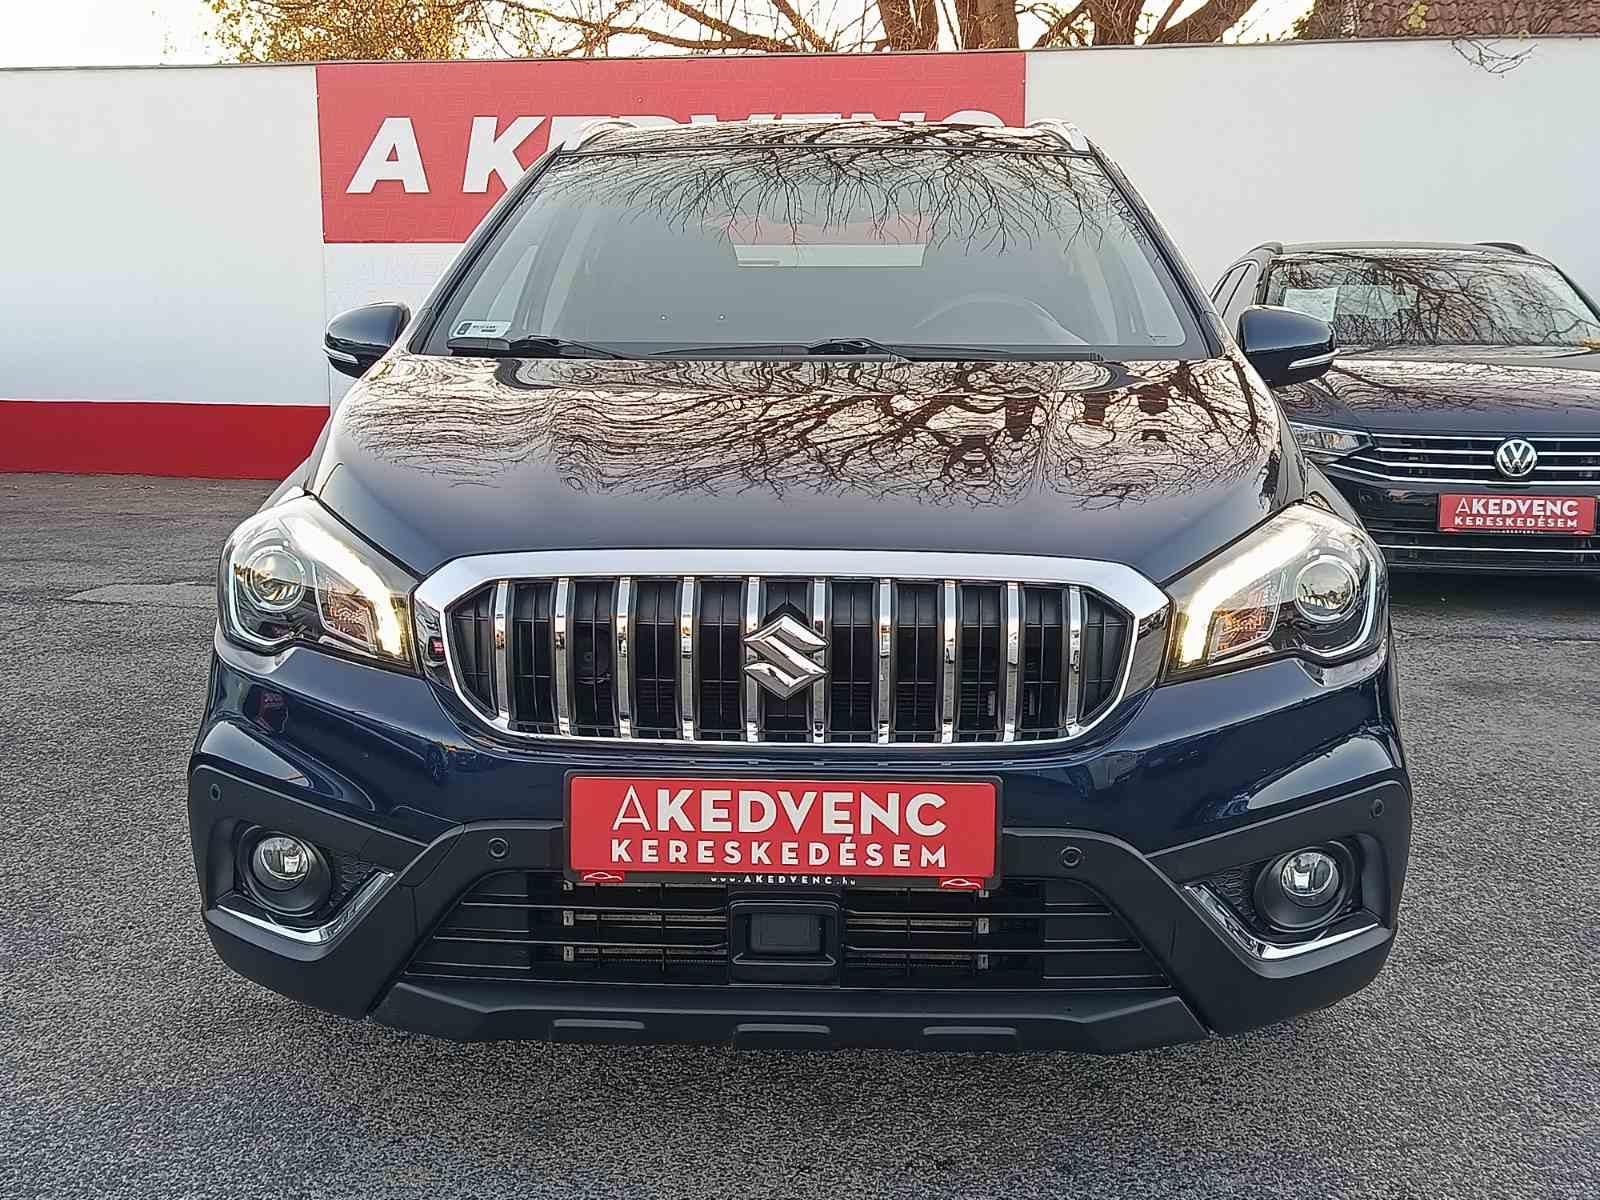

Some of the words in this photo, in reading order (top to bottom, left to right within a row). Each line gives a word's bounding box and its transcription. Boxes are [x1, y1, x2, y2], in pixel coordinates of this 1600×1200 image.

[345, 115, 431, 194] A
[1454, 516, 1578, 528] KERESKEDÉSEM
[1455, 498, 1579, 517] AKEDVENC
[611, 785, 947, 836] AKEDVENC
[610, 836, 946, 868] KERESKEDÉSEM
